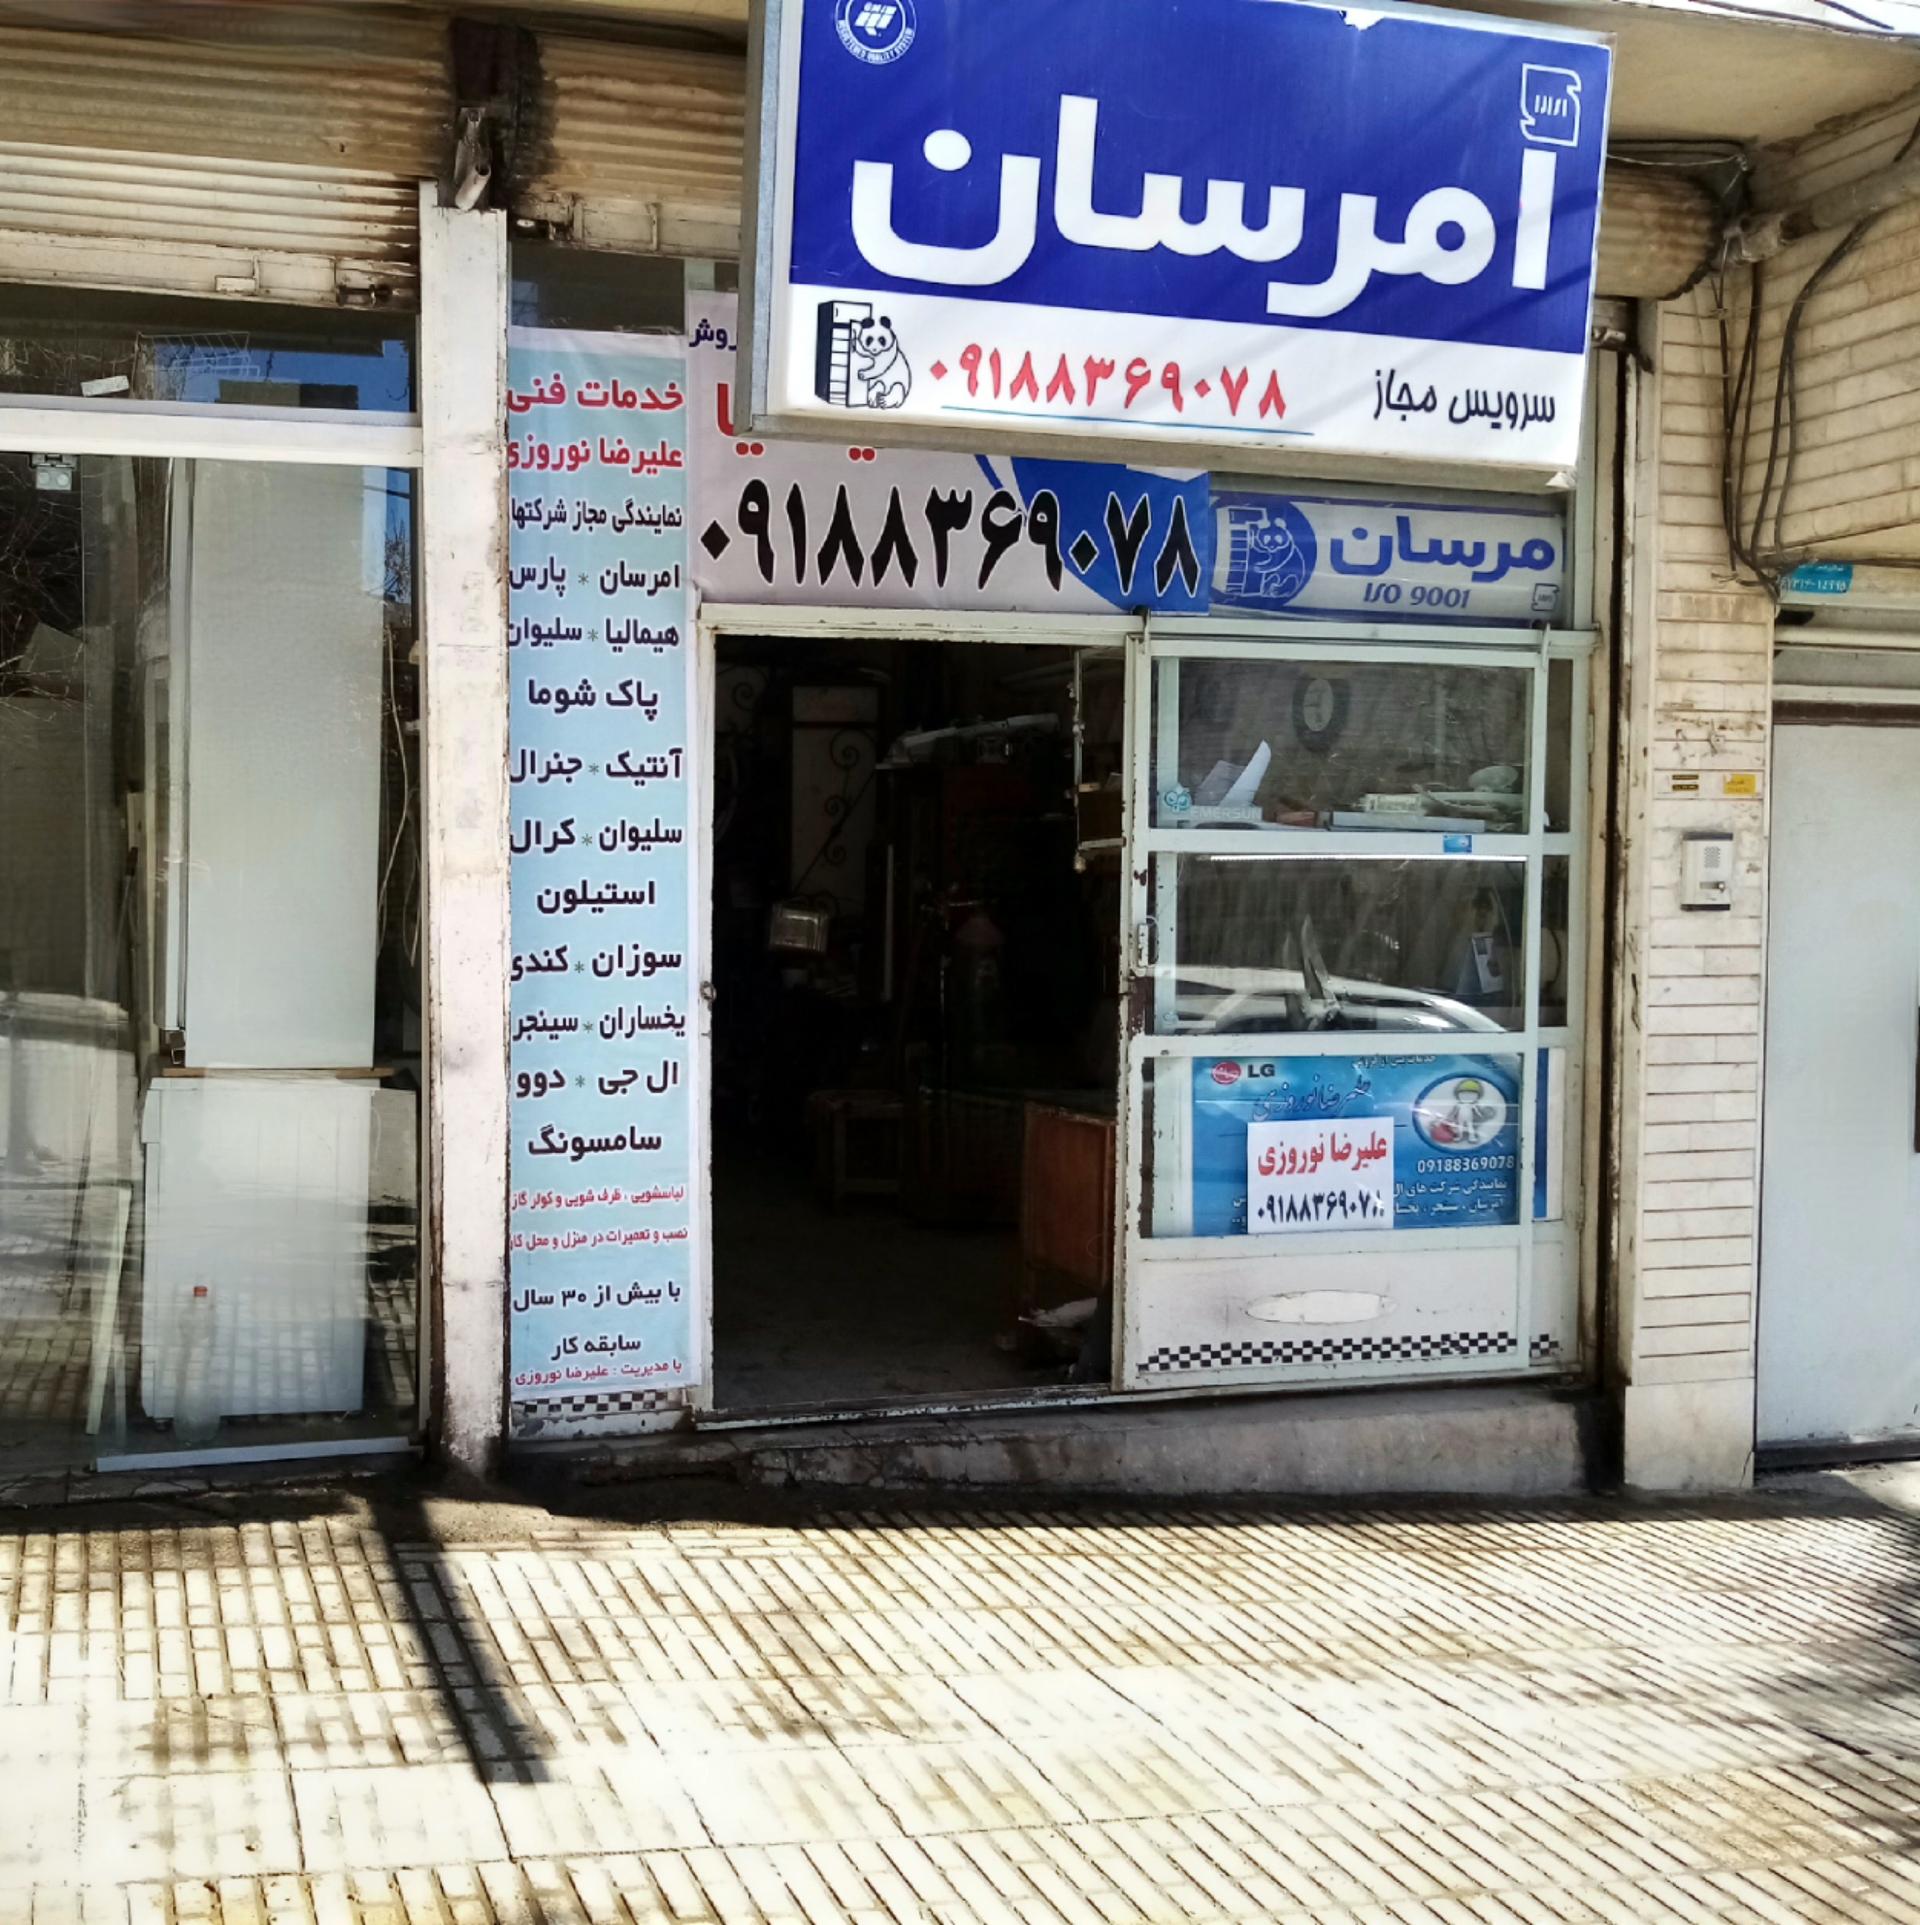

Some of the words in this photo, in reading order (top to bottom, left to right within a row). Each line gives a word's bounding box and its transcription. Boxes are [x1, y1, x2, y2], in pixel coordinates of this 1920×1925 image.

[852, 94, 1557, 319] امرسان
[509, 373, 566, 413] فنی
[576, 379, 685, 411] خدمات
[930, 343, 1287, 420] ۰۹۱۸۸۳۶۹۰۷۸
[1373, 367, 1438, 422] مجاز
[1447, 382, 1557, 430] سرویس
[509, 435, 591, 473] نوروزی
[599, 437, 684, 475] علیرضا
[573, 499, 607, 533] مجاز
[612, 499, 683, 535] نمایندگی
[699, 478, 1201, 597] ۰۹۱۸۸۳۶۹۰۷۸
[509, 555, 567, 598] پارس
[599, 559, 681, 597] امرسان
[1363, 582, 1402, 605] ISO
[1410, 584, 1471, 609] 9001
[509, 617, 583, 648] سلیوان
[604, 618, 680, 654] هیمالیا
[528, 678, 597, 714] شوما
[605, 679, 658, 722] پاک
[510, 748, 583, 784] جنرال
[605, 747, 684, 787] آنتیک
[510, 818, 575, 854] کرال
[600, 817, 683, 852] سلیوان
[536, 879, 656, 915] استیلون
[510, 945, 569, 981] کندی
[591, 943, 683, 977] سوزان
[512, 1010, 579, 1042] سینجر
[599, 1005, 686, 1039] یخساران
[515, 1068, 566, 1097] دوو
[597, 1067, 639, 1095] جی
[646, 1060, 679, 1093] ال
[1247, 1063, 1276, 1079] LG
[527, 1123, 663, 1162] سامسونگ
[1257, 1134, 1325, 1177] نوروزی
[1330, 1131, 1388, 1171] علیرضا
[1417, 1155, 1515, 1173] 09188369078
[526, 1234, 549, 1251] محل
[561, 1231, 587, 1249] منزل
[606, 1229, 650, 1246] تعمیرات
[662, 1228, 688, 1243] نصب
[513, 1289, 554, 1312] سال
[593, 1285, 611, 1307] از
[617, 1281, 662, 1305] بیش
[668, 1281, 681, 1297] با
[551, 1336, 578, 1361] کار
[583, 1334, 641, 1357] سابقه
[514, 1371, 561, 1386] نوروزی
[566, 1365, 609, 1381] علیرضا
[620, 1361, 669, 1377] مدیریت
[672, 1358, 682, 1372] با
